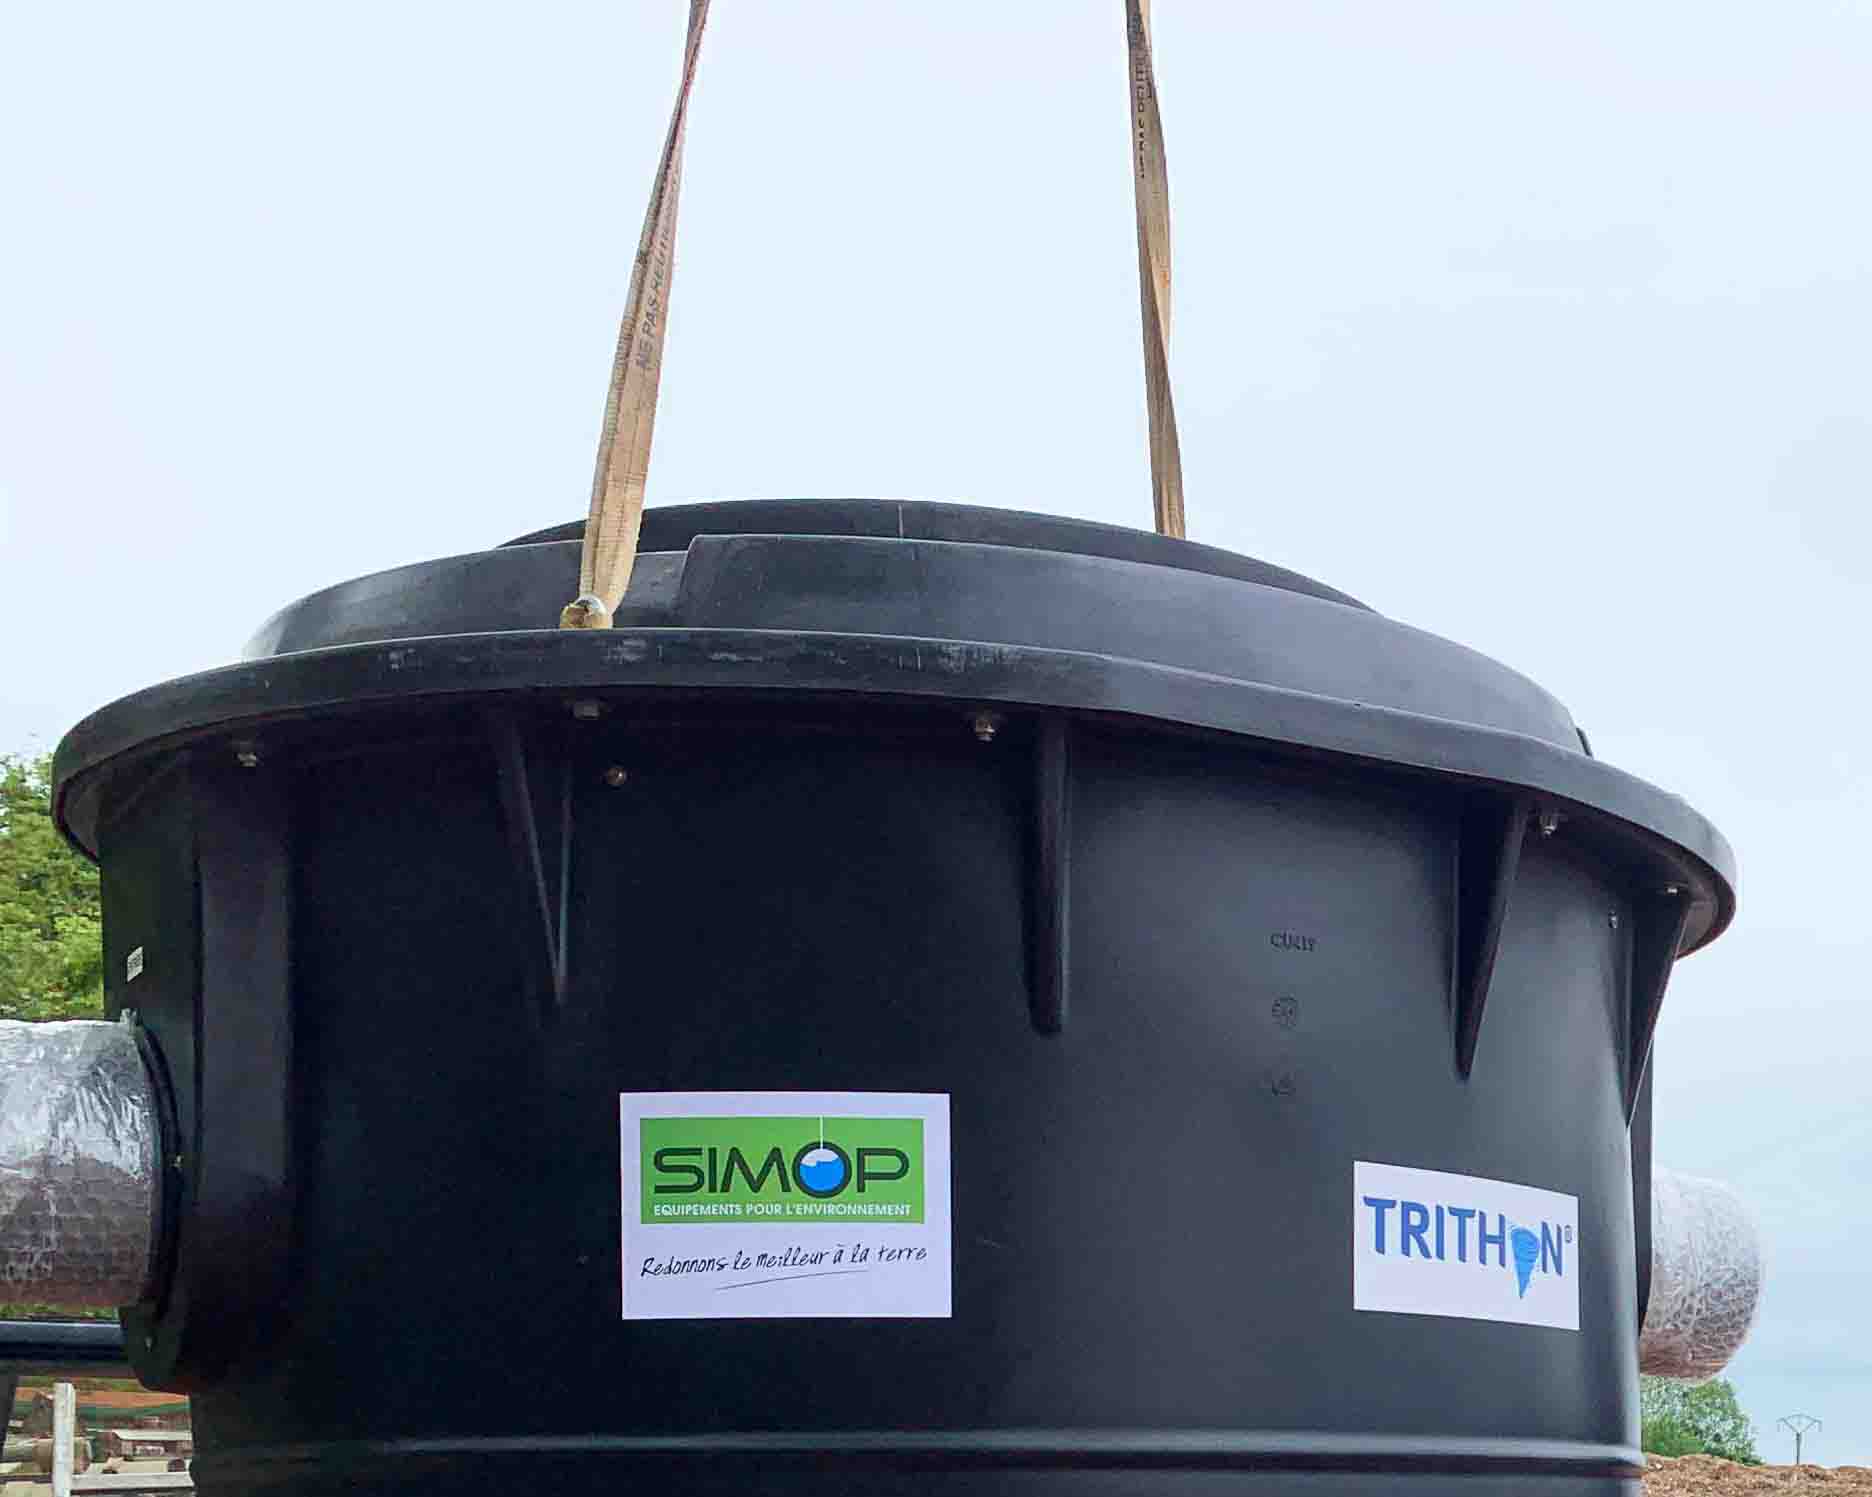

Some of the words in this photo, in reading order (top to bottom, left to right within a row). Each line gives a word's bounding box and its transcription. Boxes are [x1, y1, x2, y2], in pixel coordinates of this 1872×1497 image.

[654, 1141, 910, 1199] SIMOP
[654, 1203, 742, 1216] EQUIPEMENTS
[746, 1203, 782, 1216] POUR
[786, 1203, 912, 1216] L'ENVIRONNEMENT
[641, 1256, 728, 1277] Redonnons
[733, 1250, 751, 1270] le
[850, 1243, 870, 1263] la
[878, 1246, 927, 1262] terre
